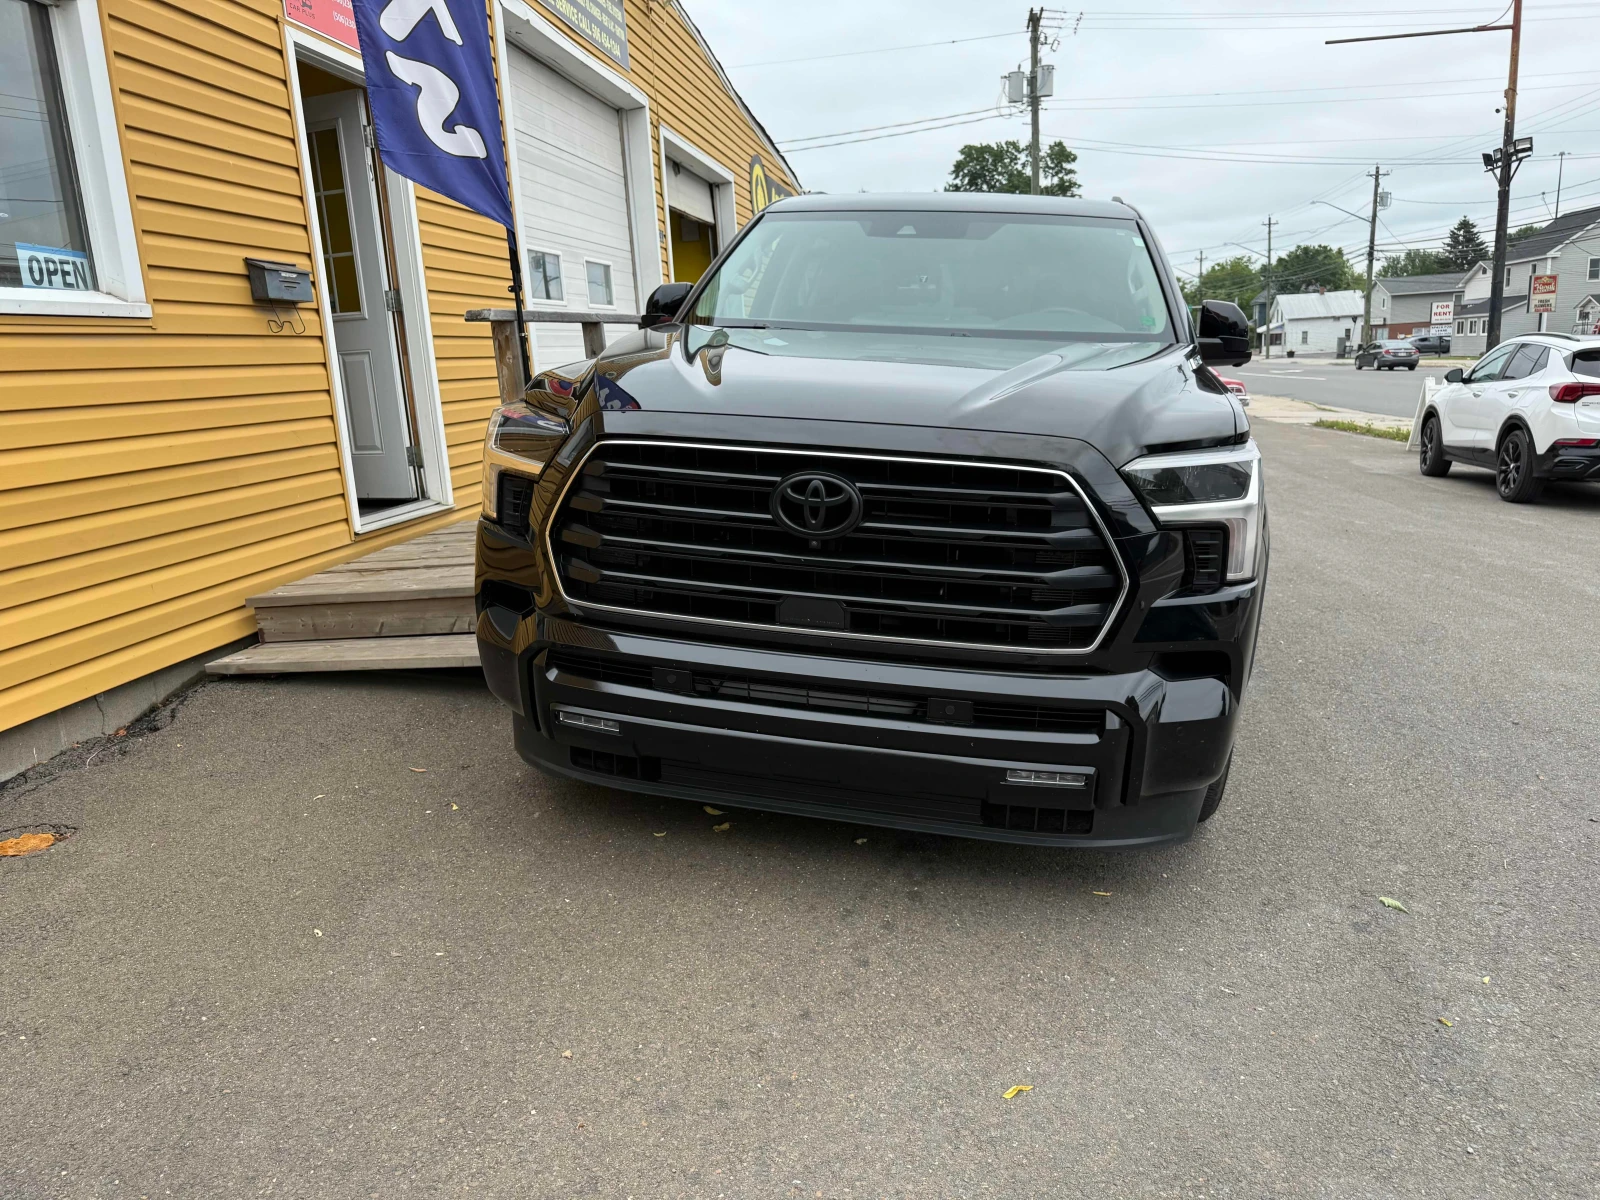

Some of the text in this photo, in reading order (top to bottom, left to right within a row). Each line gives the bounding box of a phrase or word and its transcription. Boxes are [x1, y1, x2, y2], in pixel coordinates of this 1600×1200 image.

[289, 3, 316, 20] CAR PLUS
[578, 12, 592, 36] CALL
[592, 23, 601, 43] 506
[27, 254, 89, 290] OPEN
